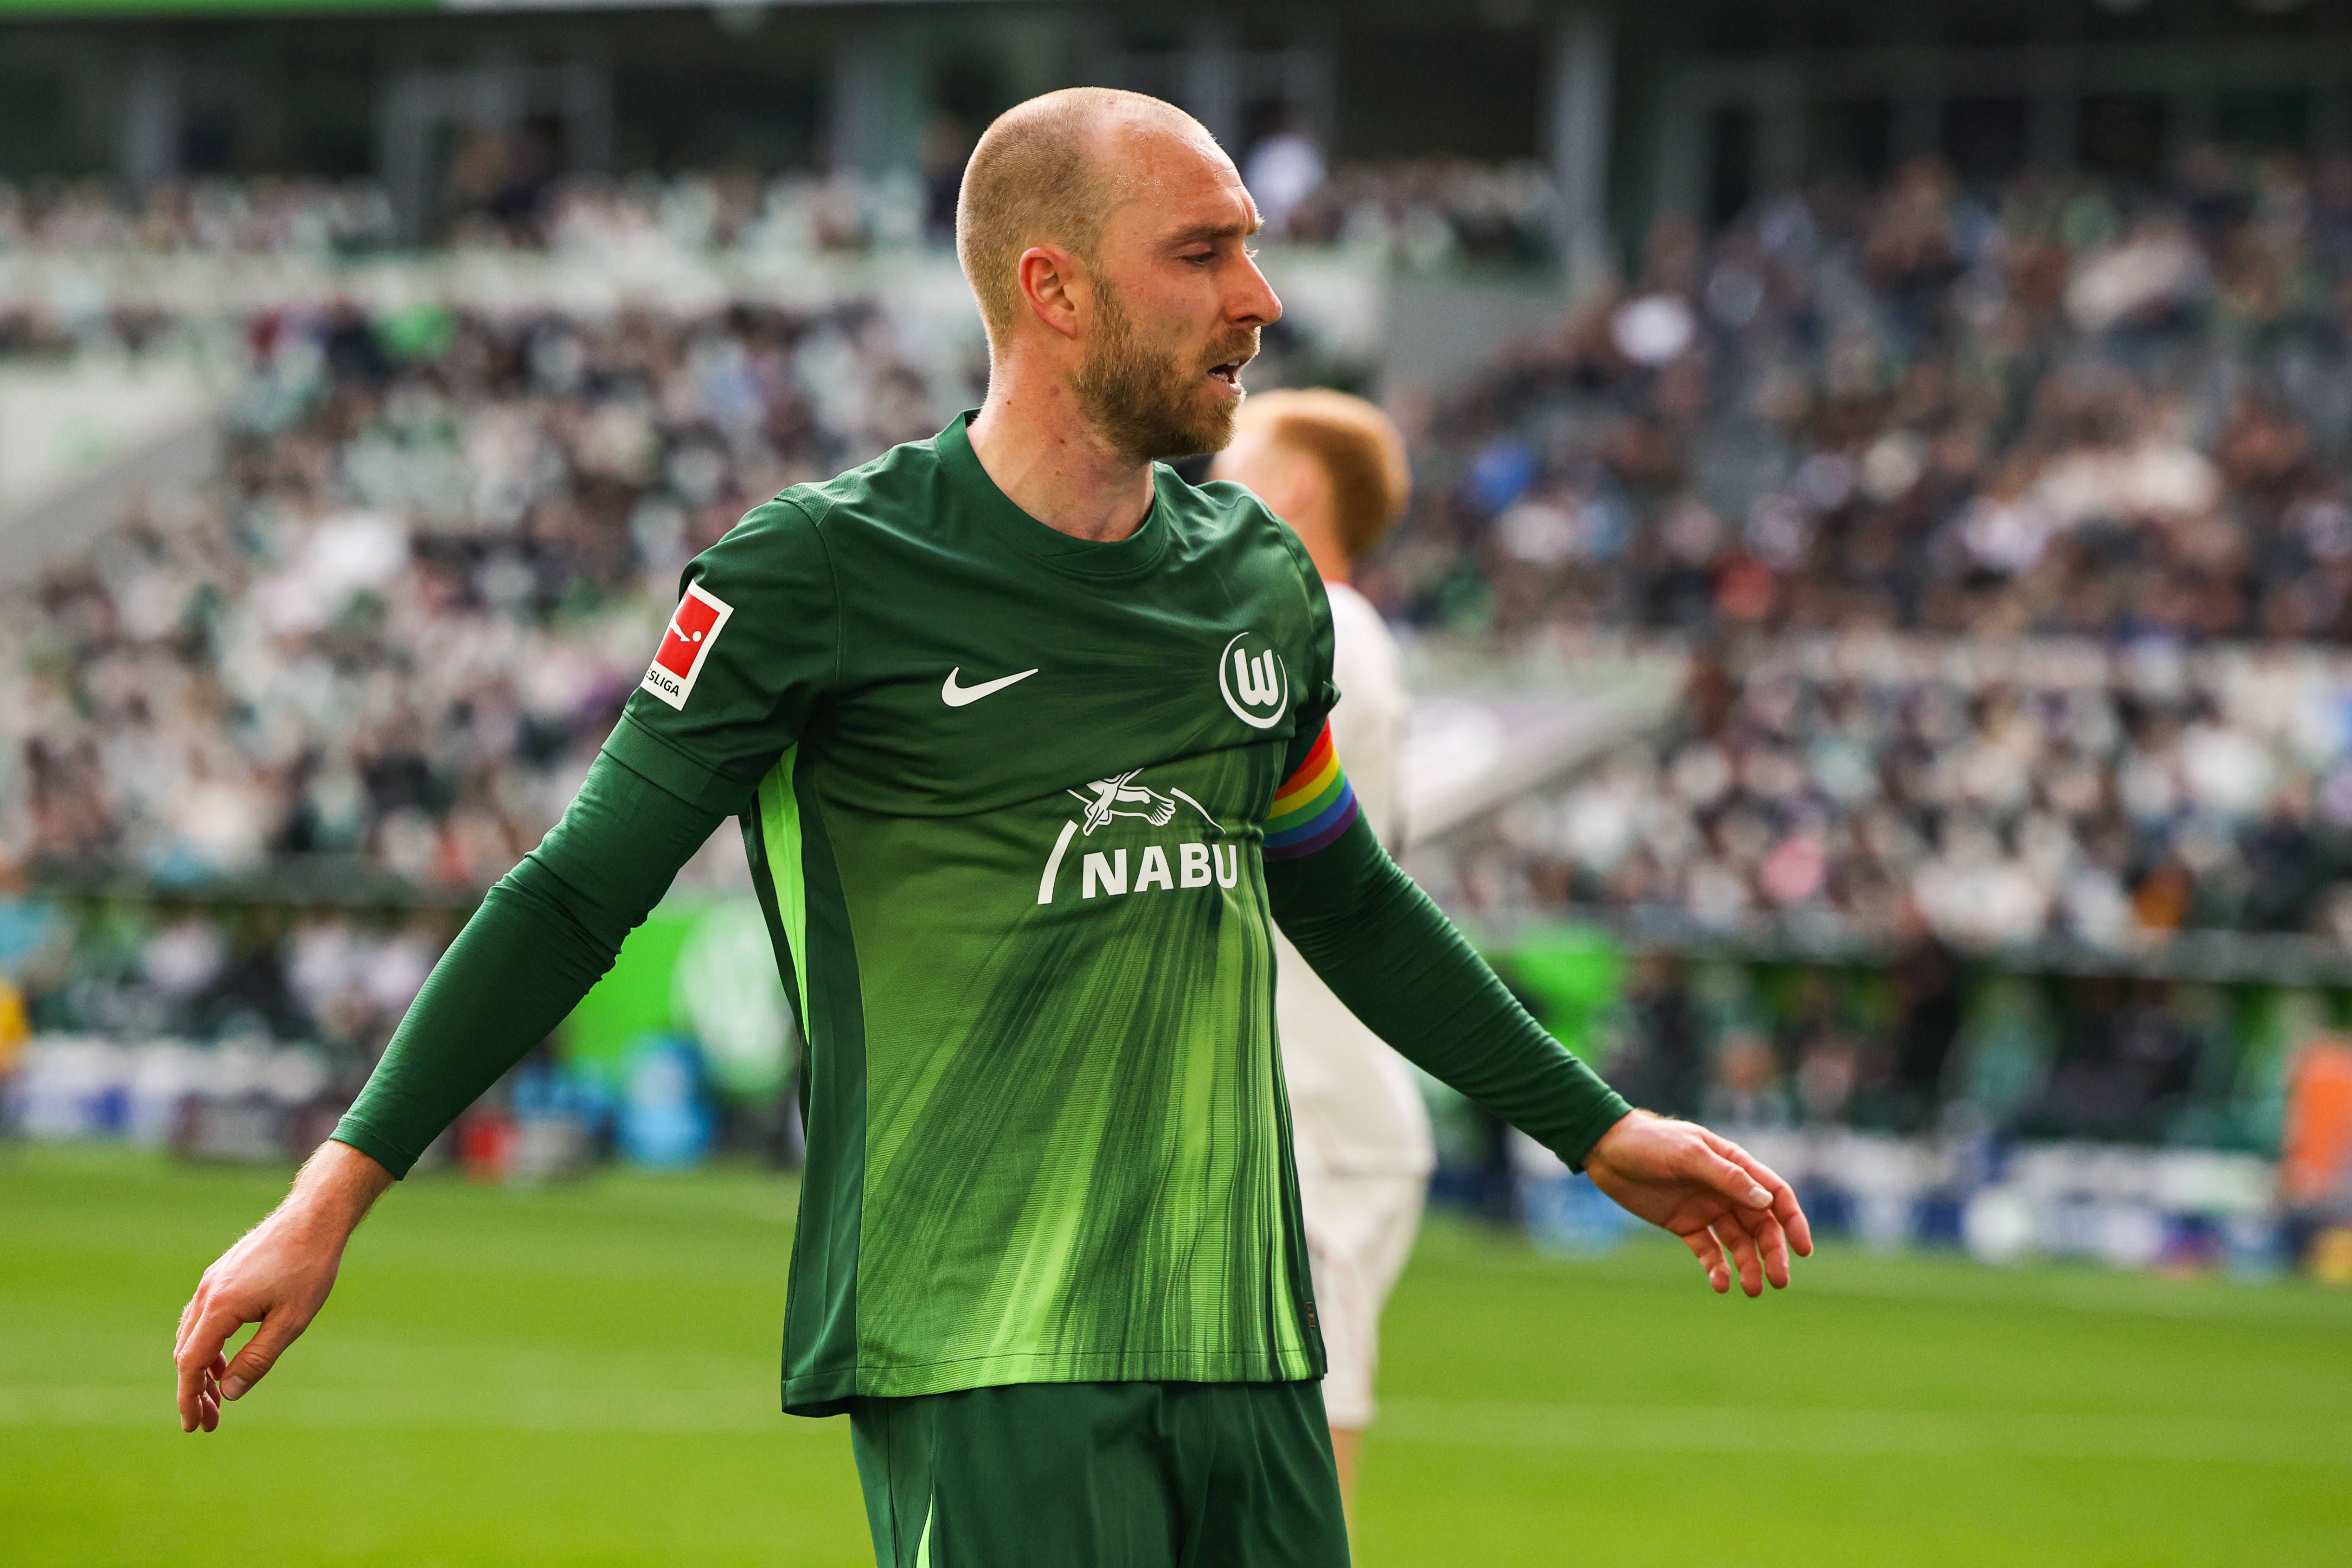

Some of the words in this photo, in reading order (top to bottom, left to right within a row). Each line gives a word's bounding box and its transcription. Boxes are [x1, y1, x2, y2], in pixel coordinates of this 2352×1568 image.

[646, 668, 679, 697] SLIGA
[1234, 648, 1279, 706] W
[1082, 843, 1237, 899] NABU
